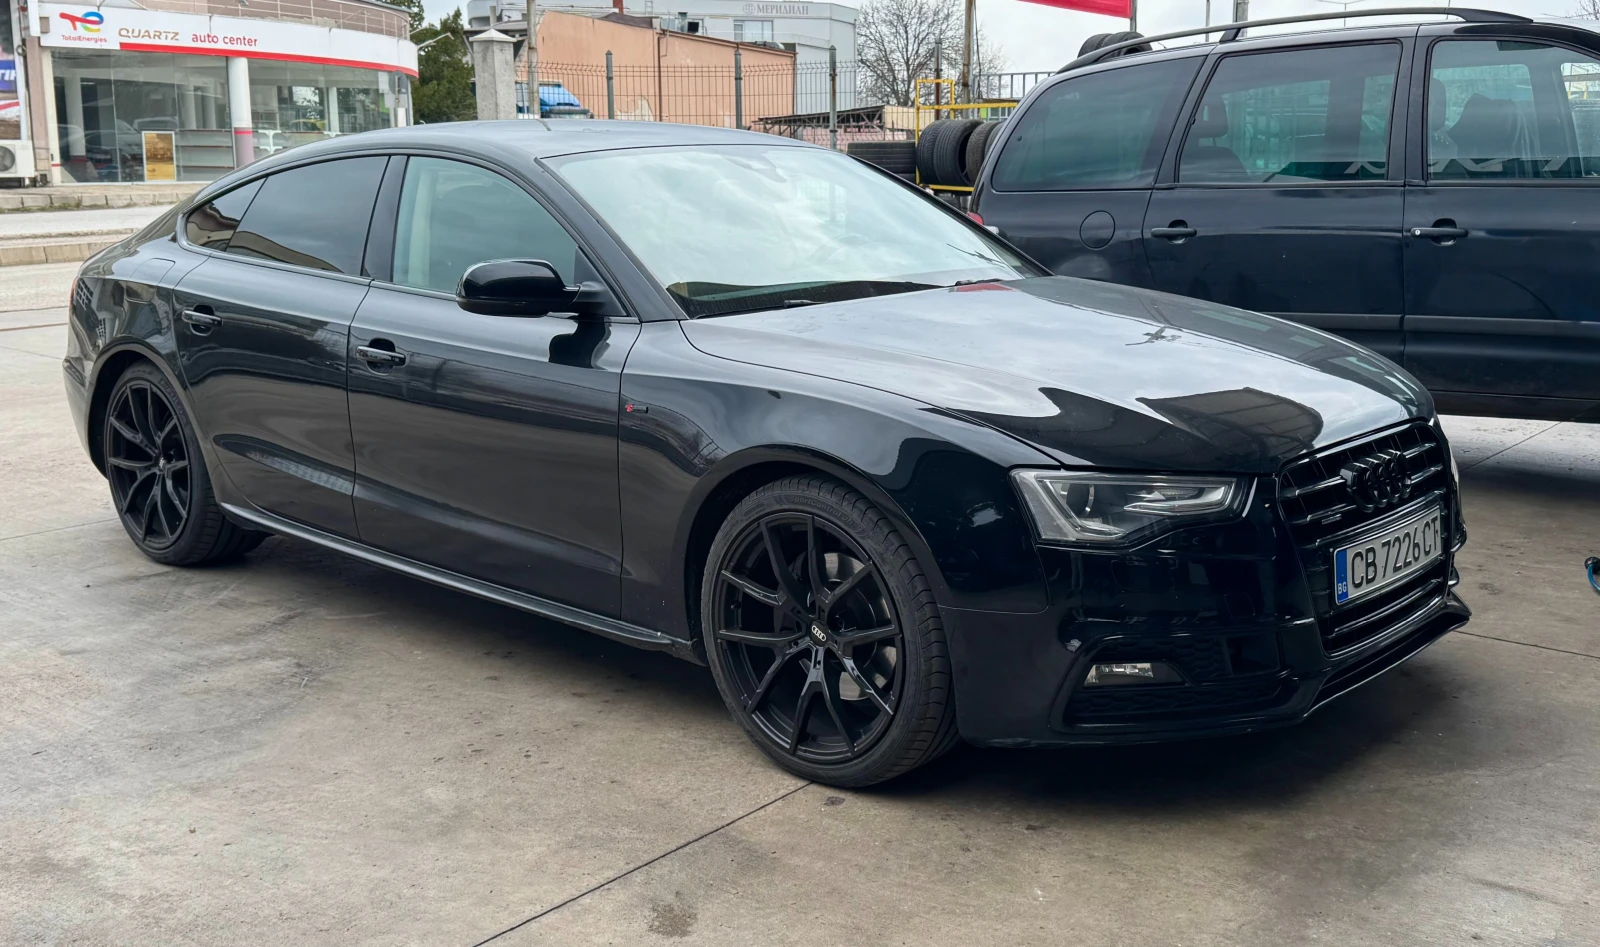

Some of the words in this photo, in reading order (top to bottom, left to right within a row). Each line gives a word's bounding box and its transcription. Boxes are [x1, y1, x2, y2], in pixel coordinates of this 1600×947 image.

[756, 4, 808, 15] МЕРИДИАН
[61, 34, 107, 43] TotalEnergies
[118, 27, 179, 41] QUARTZ
[191, 32, 219, 44] auto
[222, 36, 258, 47] center
[1351, 545, 1377, 589] CB
[1381, 525, 1421, 579] 7226
[1422, 515, 1439, 557] CT
[1337, 581, 1347, 595] BG
